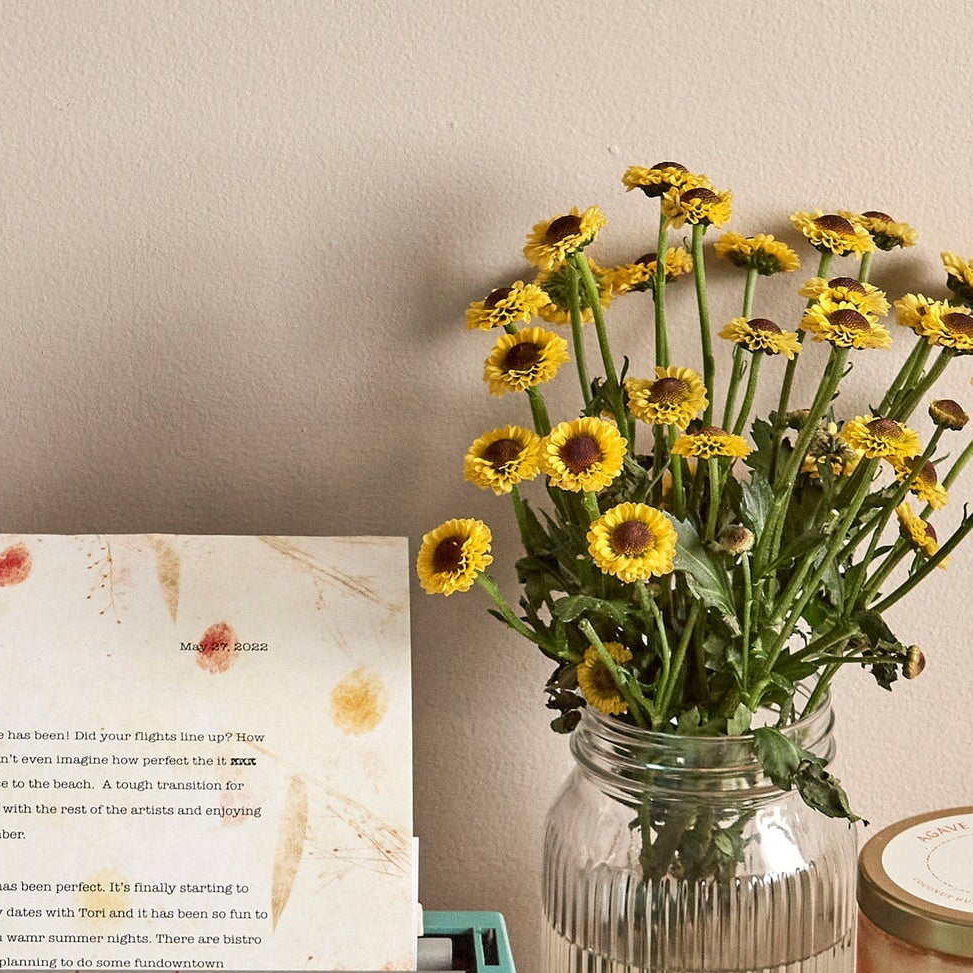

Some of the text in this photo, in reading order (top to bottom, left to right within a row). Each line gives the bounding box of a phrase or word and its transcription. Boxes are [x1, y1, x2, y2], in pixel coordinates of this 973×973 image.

[178, 640, 269, 654] May 27, 2022
[6, 730, 31, 741] has
[33, 730, 70, 742] been!
[74, 730, 96, 741] Did
[98, 731, 131, 743] your
[134, 730, 177, 744] flights
[179, 731, 204, 742] line
[207, 731, 233, 744] up?
[235, 732, 265, 743] How
[21, 755, 52, 765] even
[56, 754, 108, 767] imagine
[110, 754, 139, 766] how
[142, 755, 189, 768] perfect
[192, 755, 213, 767] the
[216, 755, 227, 767] it
[1, 803, 32, 814] with
[35, 803, 57, 815] the
[60, 804, 87, 815] rest
[89, 804, 104, 815] of
[105, 804, 127, 816] the
[130, 804, 174, 816] artists
[177, 805, 202, 816] and
[205, 804, 262, 819] enjoying
[20, 880, 52, 892] been
[55, 881, 105, 895] perfect.
[109, 881, 130, 893] It's
[133, 881, 176, 896] finally
[179, 882, 233, 896] starting
[235, 883, 249, 894] to
[5, 906, 42, 918] dates
[45, 907, 75, 918] with
[77, 907, 106, 919] Tori
[108, 907, 134, 919] and
[137, 907, 148, 919] it
[150, 907, 174, 919] has
[176, 908, 208, 920] been
[211, 910, 226, 920] so
[229, 908, 251, 920] fun
[254, 909, 268, 920] to
[59, 957, 74, 968] to
[76, 957, 93, 968] do
[95, 959, 131, 968] some
